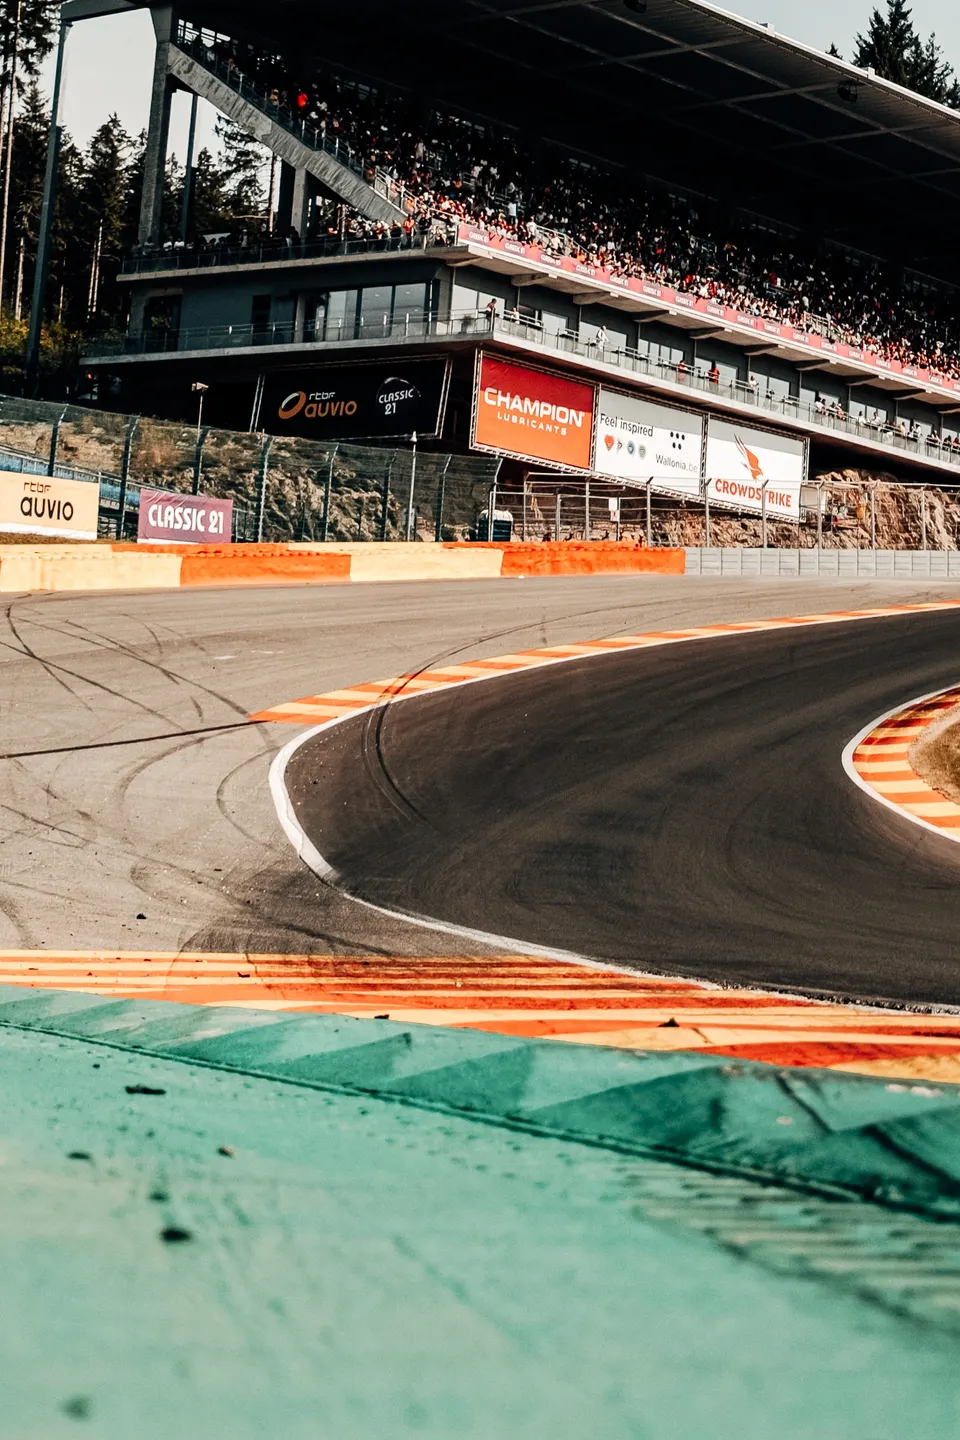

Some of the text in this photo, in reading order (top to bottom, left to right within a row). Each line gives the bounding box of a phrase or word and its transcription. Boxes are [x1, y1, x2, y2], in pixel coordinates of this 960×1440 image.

[378, 388, 414, 404] CLASSIC
[484, 387, 583, 428] CHAMPION
[384, 402, 397, 415] 21
[497, 411, 567, 436] LUBRICANTS
[600, 413, 654, 437] Feel inspired
[656, 453, 698, 472] Wallonia.be
[148, 504, 224, 534] CLASSIC 21
